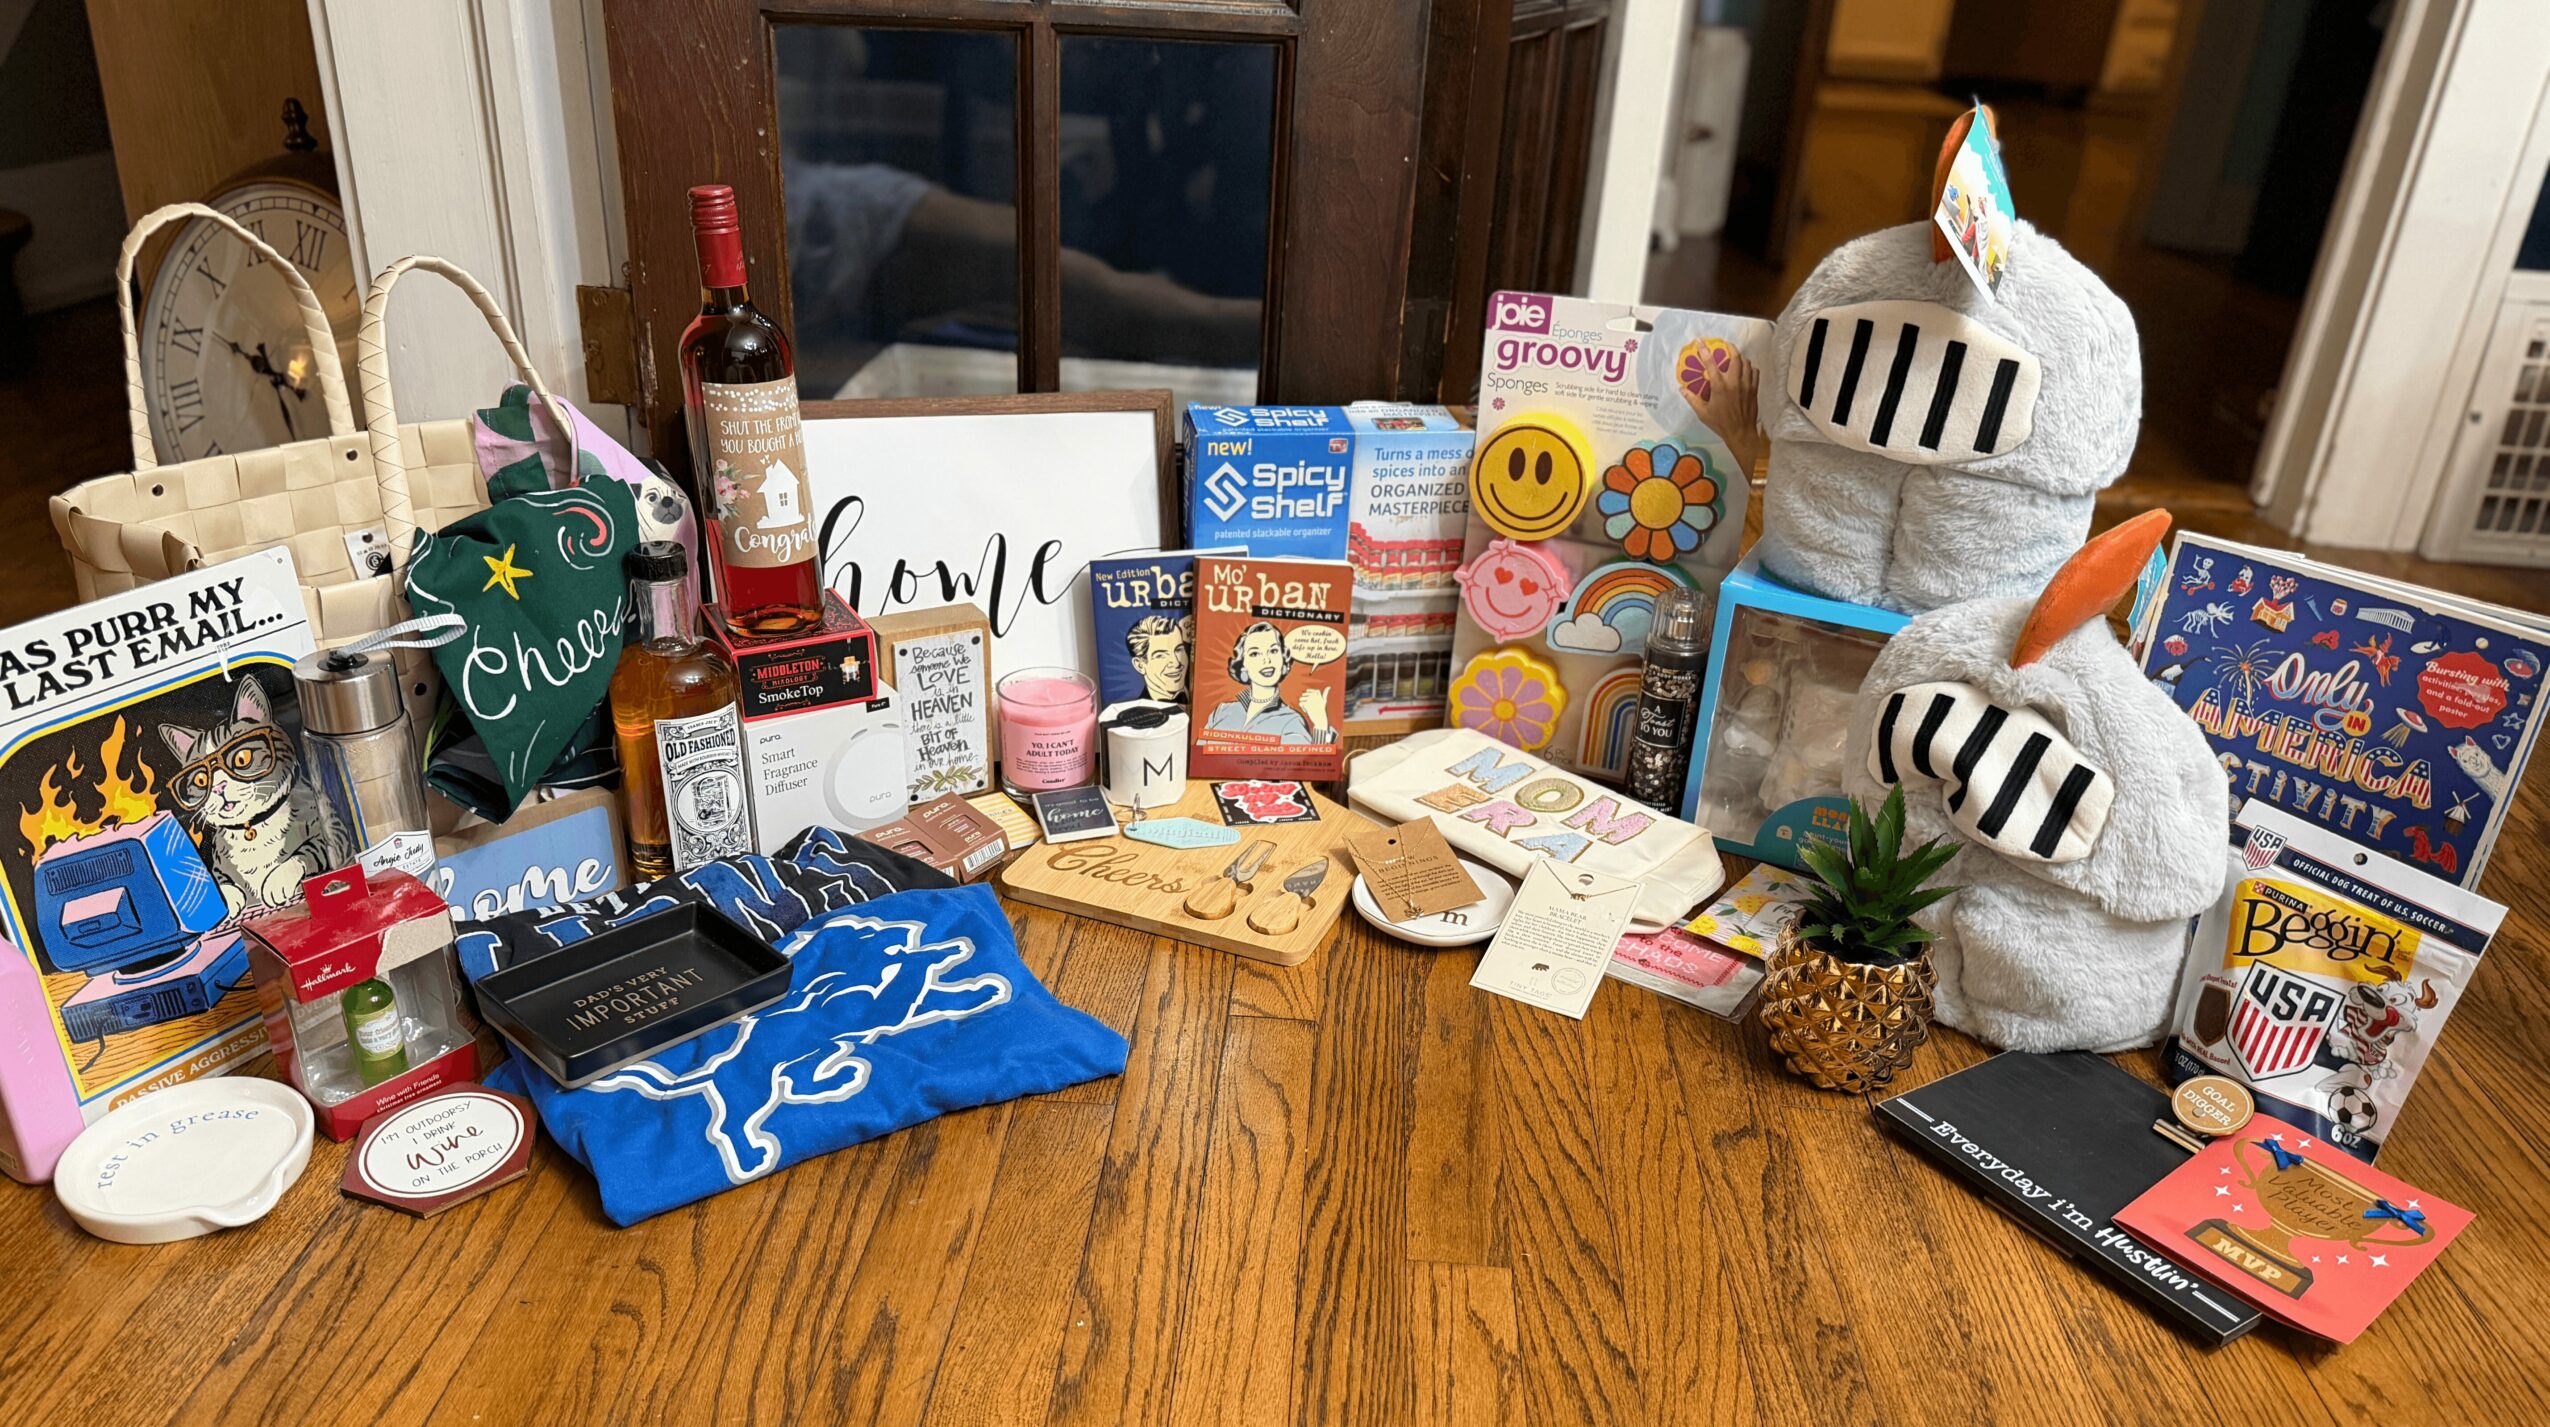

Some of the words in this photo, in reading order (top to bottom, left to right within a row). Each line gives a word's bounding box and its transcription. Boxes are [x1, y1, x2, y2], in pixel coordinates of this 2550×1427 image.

[288, 219, 328, 273] XII
[196, 256, 227, 300] X
[1491, 294, 1546, 329] joie
[1552, 321, 1603, 344] Éponges
[1497, 339, 1627, 383] groovy
[1487, 372, 1549, 396] Sponges
[1555, 382, 1583, 392] Scrubbing
[1605, 388, 1619, 396] hard
[1606, 396, 1632, 406] scrubbing
[1250, 408, 1327, 418] Spicy
[1254, 417, 1329, 426] Shelf
[720, 420, 751, 435] SHUT
[753, 420, 773, 434] THE
[720, 439, 744, 454] YOU
[748, 435, 787, 454] BOUGHT
[1207, 438, 1252, 456] new!
[1374, 447, 1411, 461] Turns
[1415, 451, 1423, 461] a
[1426, 449, 1462, 460] mess
[1252, 460, 1346, 492] Spicy
[1372, 463, 1415, 481] spices
[1419, 463, 1446, 477] into
[1449, 465, 1466, 476] an
[1371, 482, 1465, 498] ORGANIZED
[1250, 492, 1344, 519] Shelf
[1369, 500, 1470, 516] MASTERPIECE
[1214, 529, 1250, 541] patented
[1252, 528, 1291, 538] stackable
[1293, 528, 1332, 539] organizer
[818, 495, 1092, 639] home
[1095, 573, 1113, 581] New
[1116, 568, 1151, 579] Edition
[1261, 608, 1341, 621] DICTIONARY
[0, 639, 56, 681] AS
[62, 602, 180, 658] PURR
[188, 577, 244, 620] MY
[3, 651, 116, 710] LAST
[127, 607, 284, 669] EMAIL...
[911, 642, 967, 665] Because
[756, 659, 820, 680] MIDDLETON
[909, 660, 951, 675] someone
[917, 666, 970, 691] LOVE
[2425, 661, 2479, 686] Bursting
[2481, 677, 2510, 691] with
[771, 675, 809, 686] MIXOLOGY
[948, 685, 960, 695] in
[2264, 652, 2375, 732] Only
[758, 684, 824, 704] SmokeTop
[2426, 688, 2445, 699] and
[2454, 695, 2490, 713] fold-out
[911, 692, 973, 721] HEAVEN
[1655, 705, 1661, 714] A
[2438, 705, 2468, 718] poster
[910, 722, 932, 735] there
[953, 712, 975, 725] little
[1652, 727, 1674, 738] YOU
[2347, 714, 2366, 732] IN
[665, 741, 687, 763] OLD
[688, 727, 736, 755] FASHIONED
[760, 733, 781, 745] pura
[920, 730, 942, 746] BIT
[944, 728, 959, 740] OF
[1031, 742, 1044, 750] YO,
[1050, 739, 1074, 749] CAN'T
[1202, 730, 1277, 743] RIDONKULOUS
[2188, 686, 2432, 810] AMERICA
[761, 748, 796, 765] Smart
[916, 739, 970, 762] Heaven
[1054, 746, 1079, 757] TODAY
[1250, 745, 1285, 753] SLANG
[1543, 745, 1553, 760] 6
[762, 759, 818, 781] Fragrance
[914, 762, 926, 772] in
[928, 757, 944, 768] our
[1143, 753, 1172, 786] M
[764, 777, 808, 797] Diffuser
[869, 791, 892, 803] pura
[1444, 746, 1657, 846] MOM
[923, 801, 951, 819] pura
[875, 826, 903, 839] pura
[1413, 782, 1594, 864] ERA
[2253, 828, 2281, 850] USA
[1046, 843, 1190, 894] Cheers
[437, 856, 612, 920] home
[2265, 887, 2304, 911] PURINA
[2293, 859, 2330, 880] OFFICIAL
[2331, 876, 2349, 889] DOG
[2350, 884, 2379, 903] TREAT
[2380, 897, 2393, 908] OF
[2394, 903, 2408, 917] U.S.
[2409, 910, 2446, 932] SOCCER
[1440, 910, 1468, 927] m
[1548, 905, 1570, 916] MAMA
[1570, 910, 1587, 920] BEAR
[1549, 912, 1583, 925] BRACELET
[2232, 897, 2403, 965] Beggin'
[301, 963, 357, 992] Hallmark
[573, 981, 624, 1008] DAD'S
[625, 967, 668, 986] VERY
[566, 967, 704, 1031] IMPORTANT
[2249, 967, 2336, 1022] USA
[623, 997, 682, 1024] STUFF
[190, 1026, 269, 1075] AGGRESSI
[375, 1095, 396, 1107] Wine
[397, 1086, 413, 1098] with
[413, 1073, 440, 1089] Friends
[2201, 1085, 2237, 1112] GOAL
[2182, 1088, 2231, 1127] DIGGER
[381, 1132, 400, 1145] I'M
[405, 1100, 472, 1134] OUTDOORSY
[424, 1121, 456, 1140] DRINK
[97, 1154, 129, 1189] rest
[126, 1131, 160, 1148] in
[170, 1109, 259, 1135] grease
[406, 1126, 484, 1170] Wine
[412, 1175, 431, 1188] ON
[438, 1163, 460, 1176] THE
[465, 1142, 503, 1164] PORCH
[2267, 1175, 2365, 1231] Valuable
[2295, 1176, 2354, 1210] Most
[1929, 1120, 2053, 1202] Everyday
[2047, 1198, 2094, 1232] i'm
[2094, 1225, 2199, 1293] Hustlin'
[2268, 1192, 2342, 1232] Player
[2212, 1236, 2283, 1280] MVP
